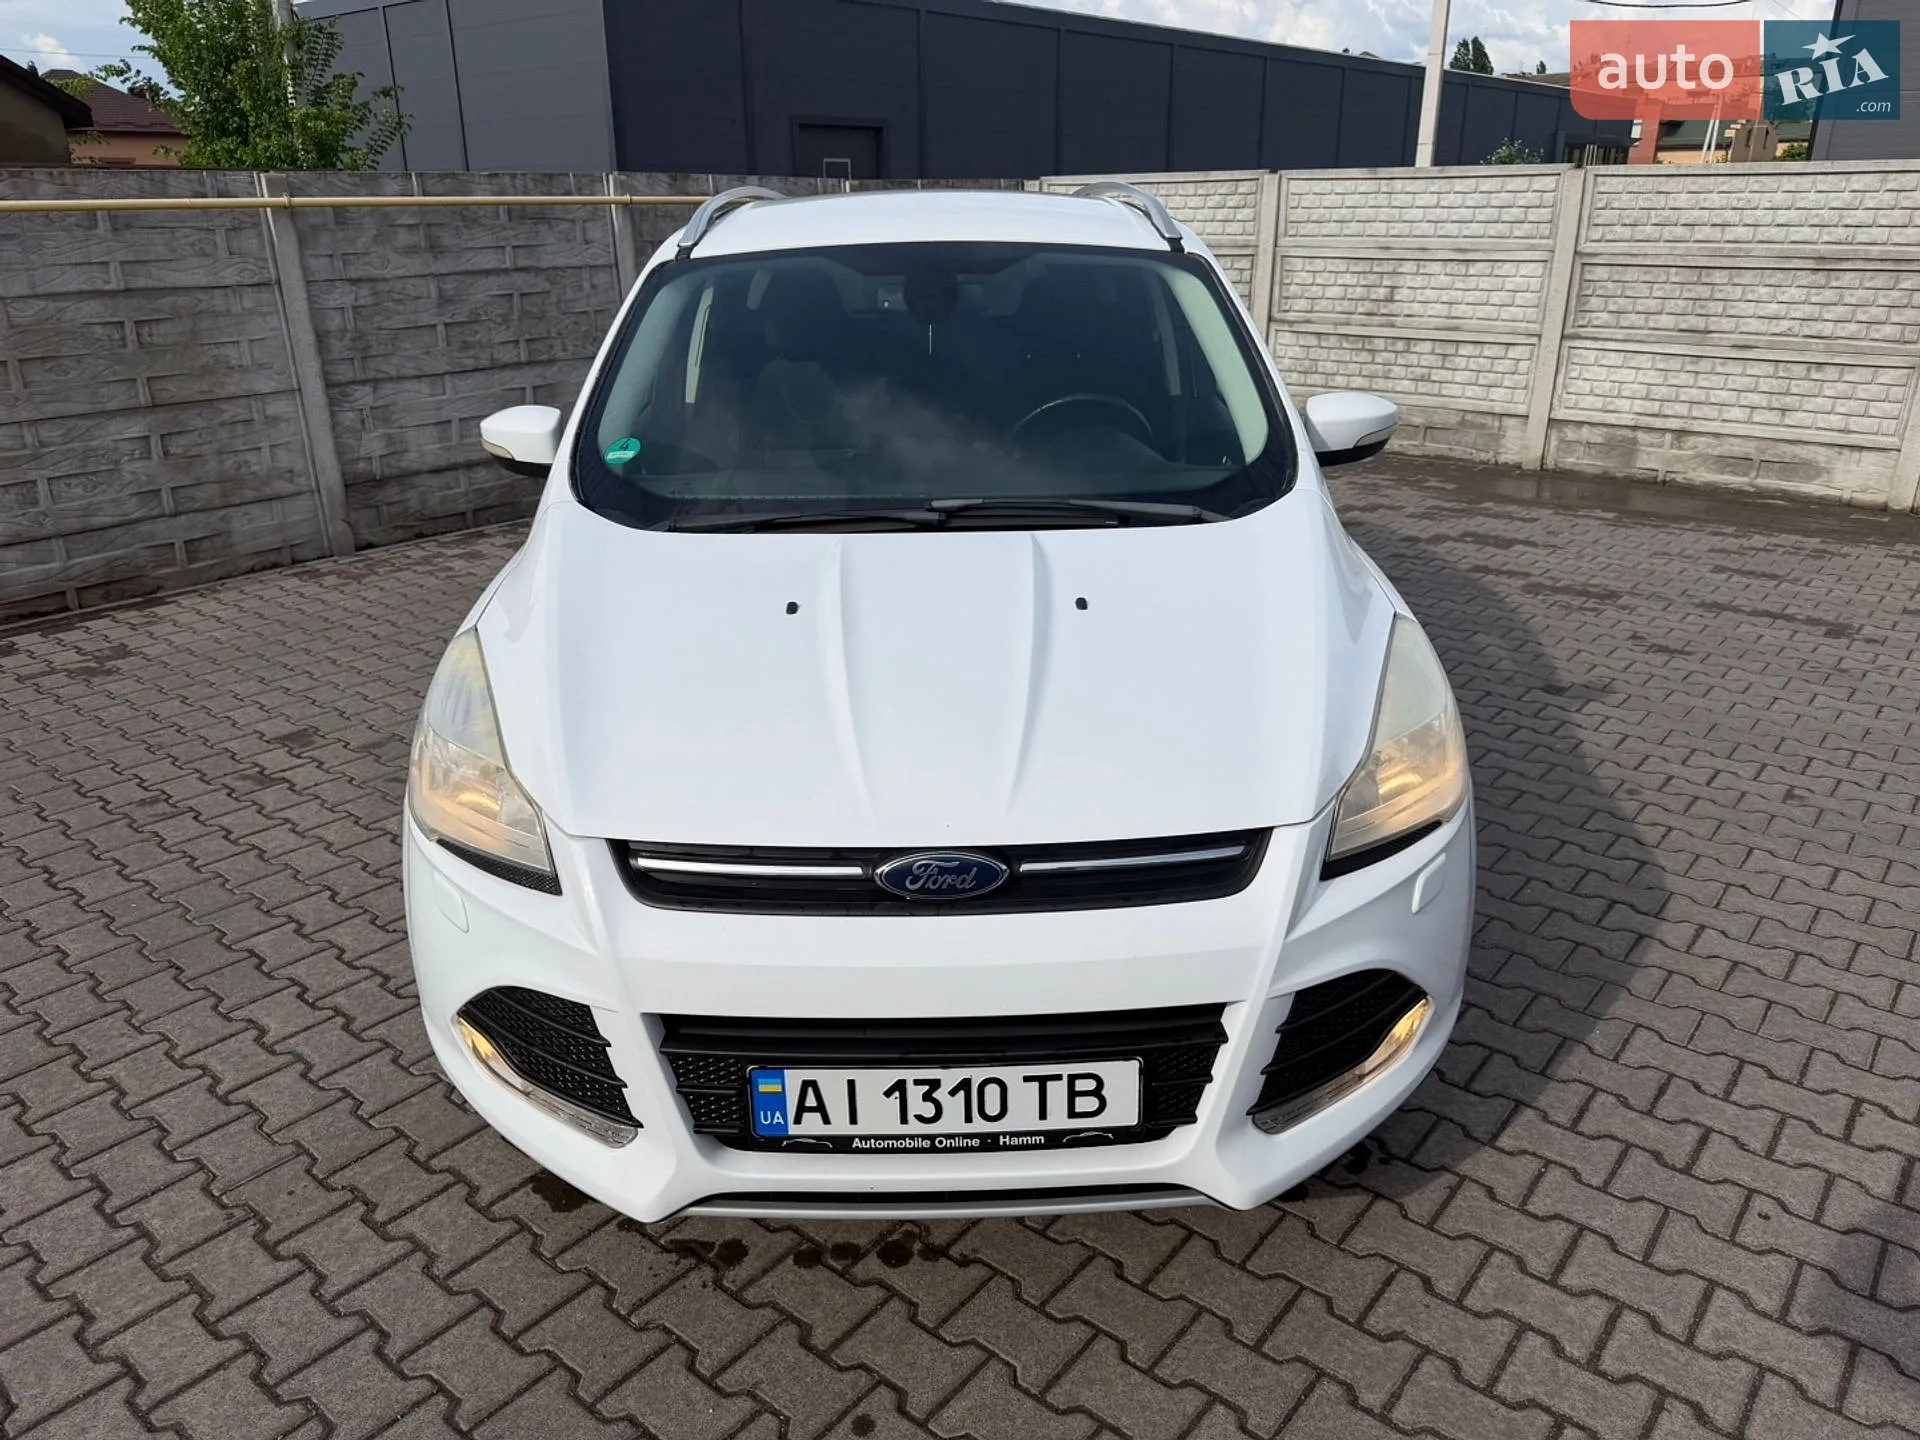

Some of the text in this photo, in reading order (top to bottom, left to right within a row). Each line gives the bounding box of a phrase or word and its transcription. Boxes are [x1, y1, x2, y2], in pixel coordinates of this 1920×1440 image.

[905, 860, 978, 890] Ford
[793, 1072, 1107, 1125] AI 1310 TB
[760, 1110, 784, 1125] UA
[852, 1134, 1045, 1149] Automobile Online Hamm
